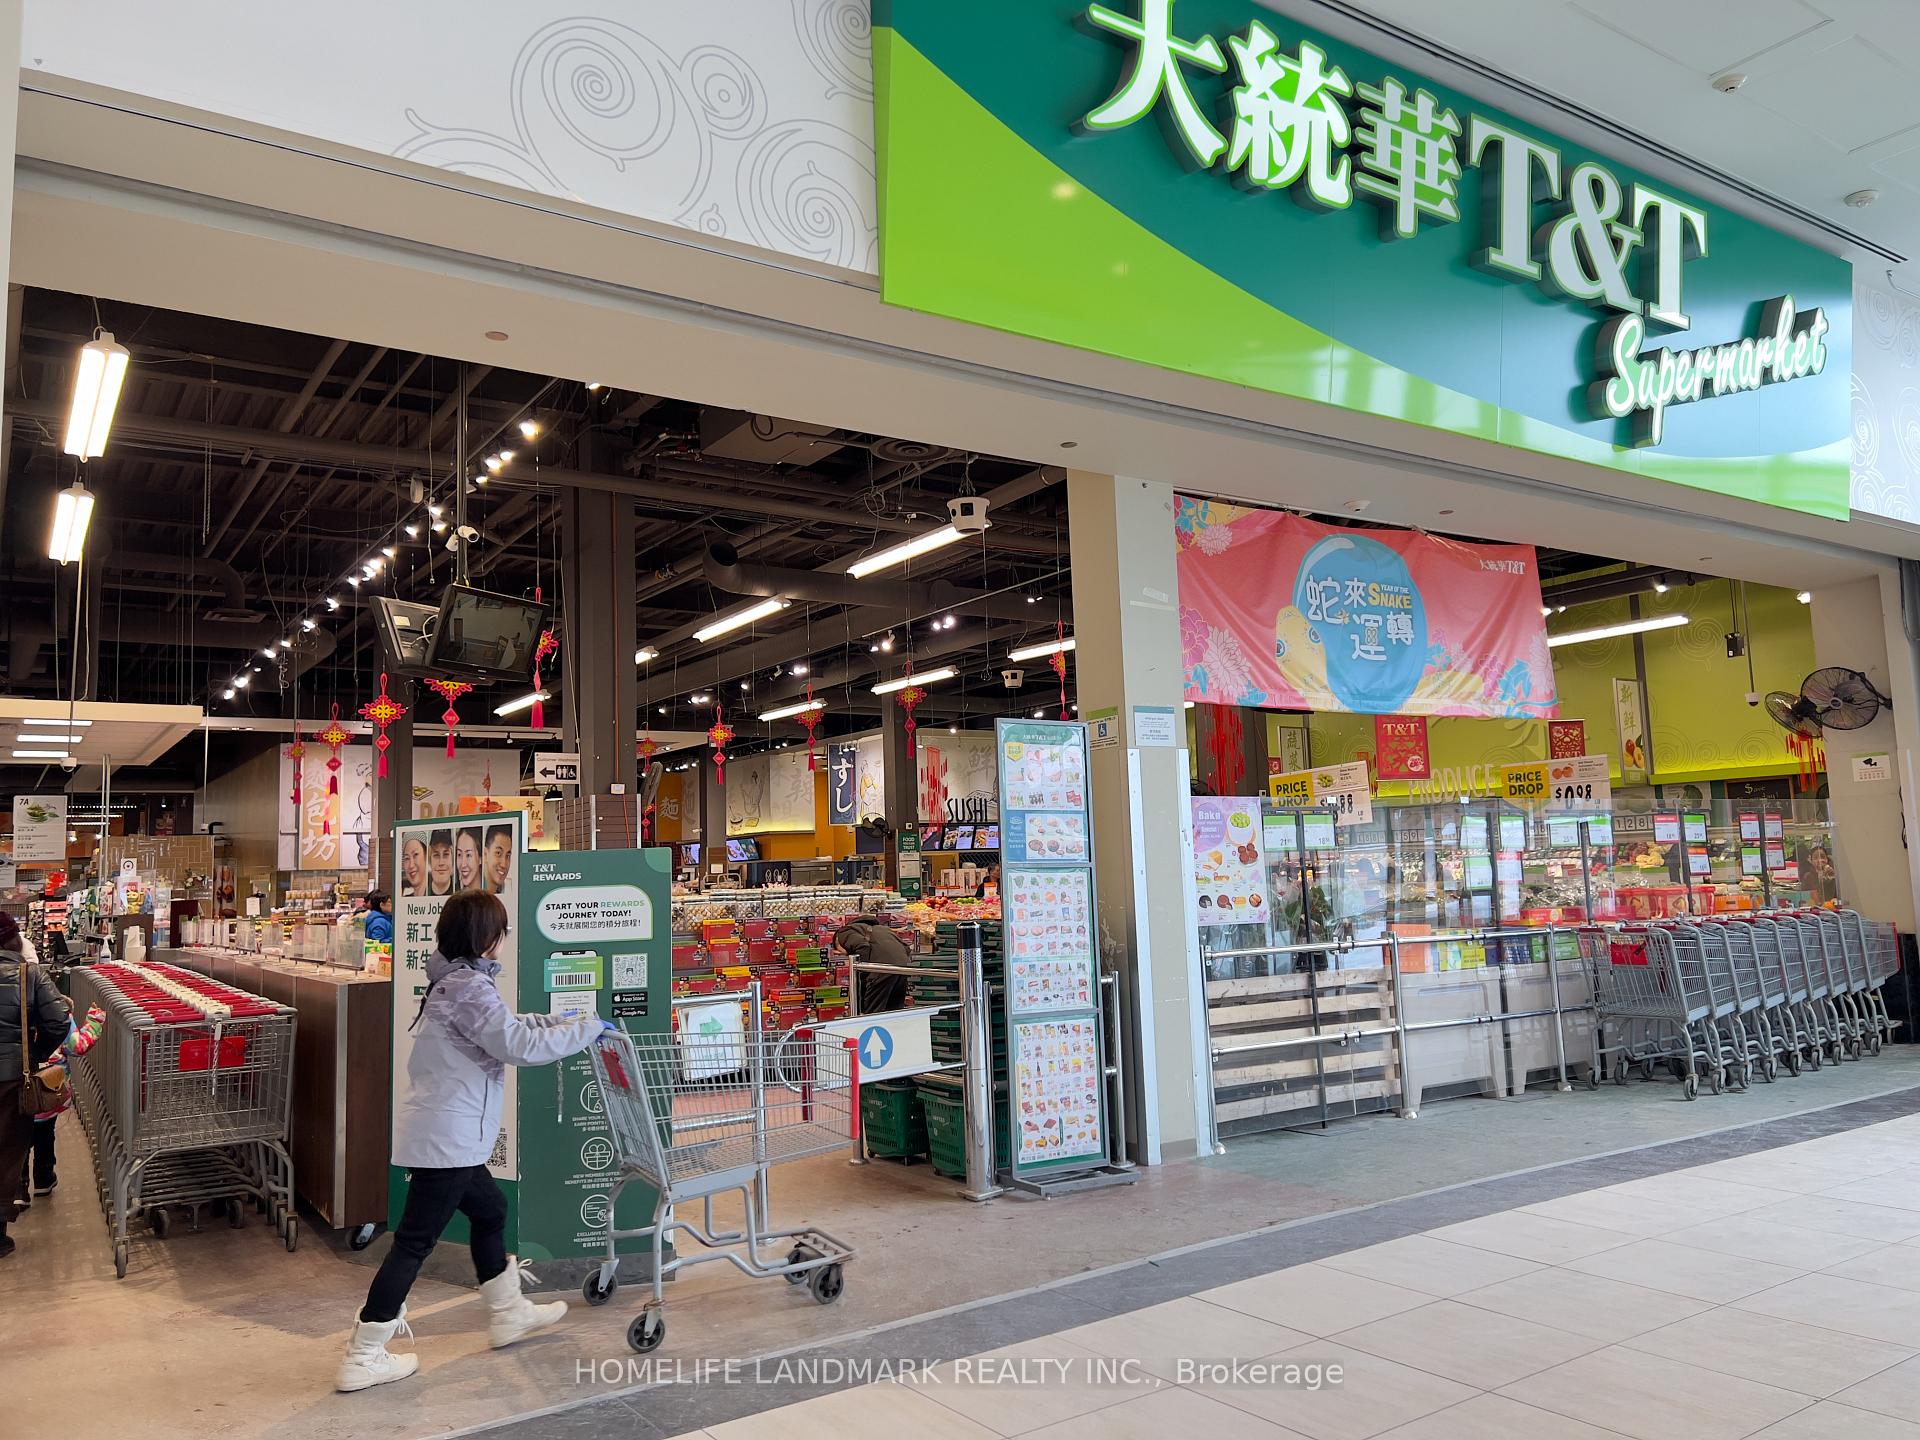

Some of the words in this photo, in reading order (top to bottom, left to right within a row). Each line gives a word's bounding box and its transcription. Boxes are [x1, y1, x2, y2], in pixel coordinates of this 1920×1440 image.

[1086, 0, 1463, 237] 大統華
[1469, 112, 1709, 331] T&T
[1605, 294, 1829, 447] Supermarket
[1381, 583, 1394, 592] YEAR
[1368, 582, 1413, 609] SNAKE
[1383, 722, 1419, 736] T&T
[1408, 764, 1496, 804] PRODUCE
[1508, 771, 1543, 783] PRICE
[831, 757, 855, 813] すし
[1276, 780, 1308, 796] PRICE
[1509, 783, 1544, 796] DROP
[19, 798, 29, 806] 7A
[1278, 793, 1310, 807] DROP
[947, 798, 988, 824] SUSHI
[532, 863, 556, 873] T&T
[532, 872, 582, 882] REWARDS
[407, 903, 426, 916] New
[545, 902, 573, 911] START
[575, 901, 599, 910] YOUR
[600, 899, 646, 909] REWARDS
[557, 911, 598, 920] JOURNEY
[600, 909, 632, 918] TODAY!
[406, 922, 438, 943] 新工
